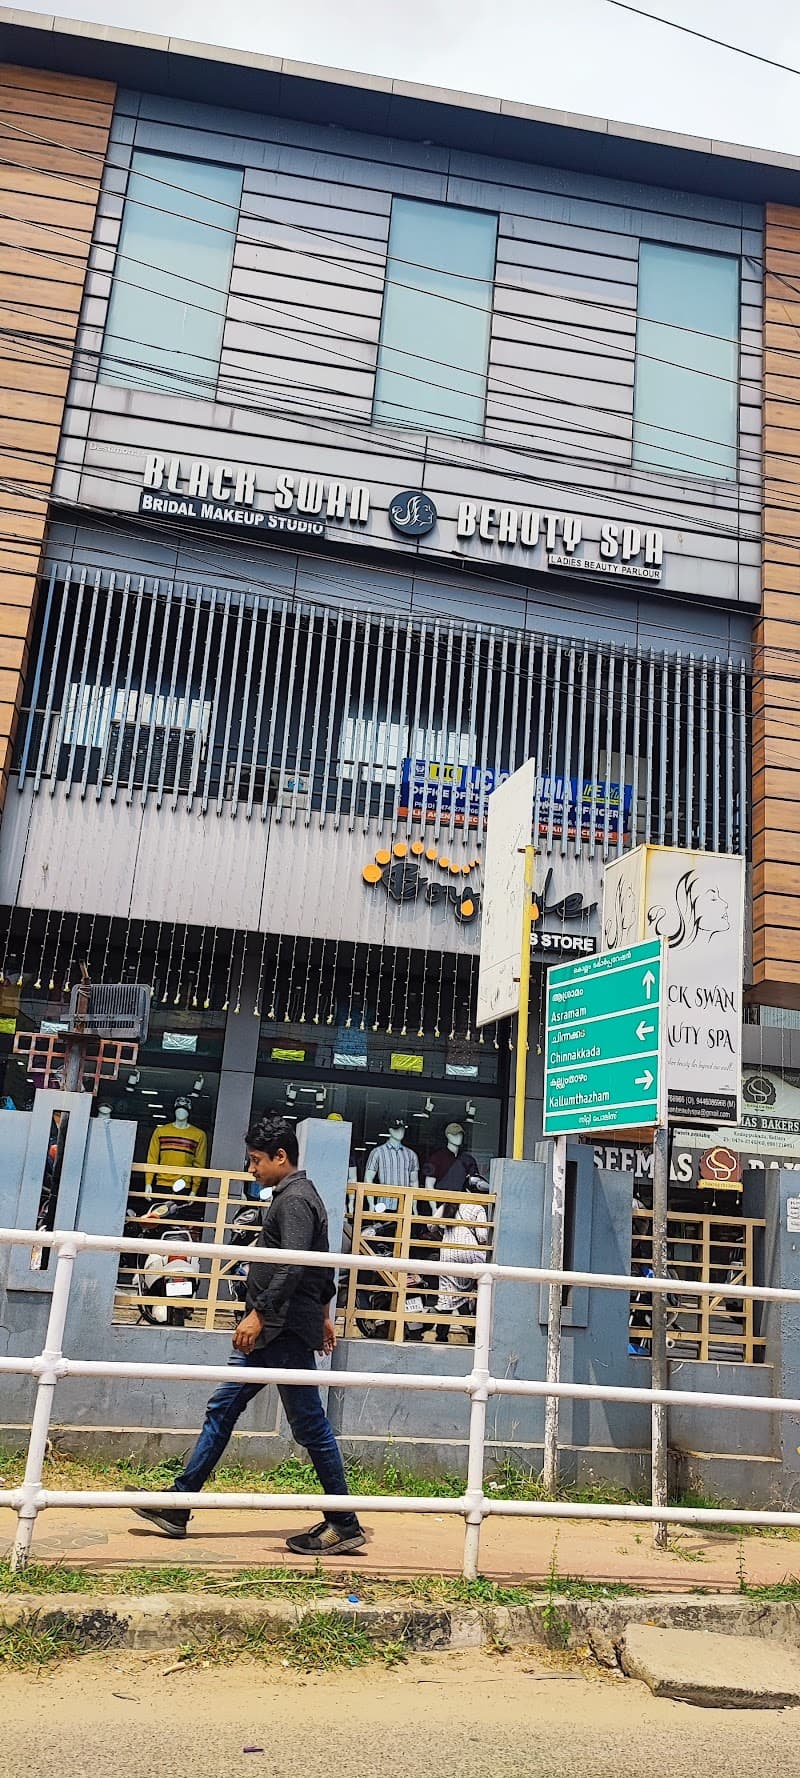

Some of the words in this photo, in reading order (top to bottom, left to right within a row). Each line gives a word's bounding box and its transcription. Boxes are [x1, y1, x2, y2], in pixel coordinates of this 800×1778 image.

[142, 495, 197, 517] BRIDAL
[201, 505, 264, 526] MAKEUP
[268, 515, 324, 535] STUDIO
[143, 454, 256, 505] BLACK
[274, 473, 370, 523] SWAN
[457, 501, 582, 552] BEAUTY
[600, 523, 663, 565] SPA
[551, 556, 582, 567] LADIES
[584, 560, 619, 573] BEAUTY
[621, 566, 660, 579] PARLOUR
[541, 933, 595, 952] STORE
[668, 984, 692, 1009] CK
[695, 984, 737, 1013] SWAN
[551, 1007, 587, 1023] Asramam
[707, 1028, 736, 1054] SPA
[550, 1045, 601, 1064] Chinnakkada
[549, 1091, 610, 1108] Kallumthazham
[761, 1118, 800, 1132] BAKERS
